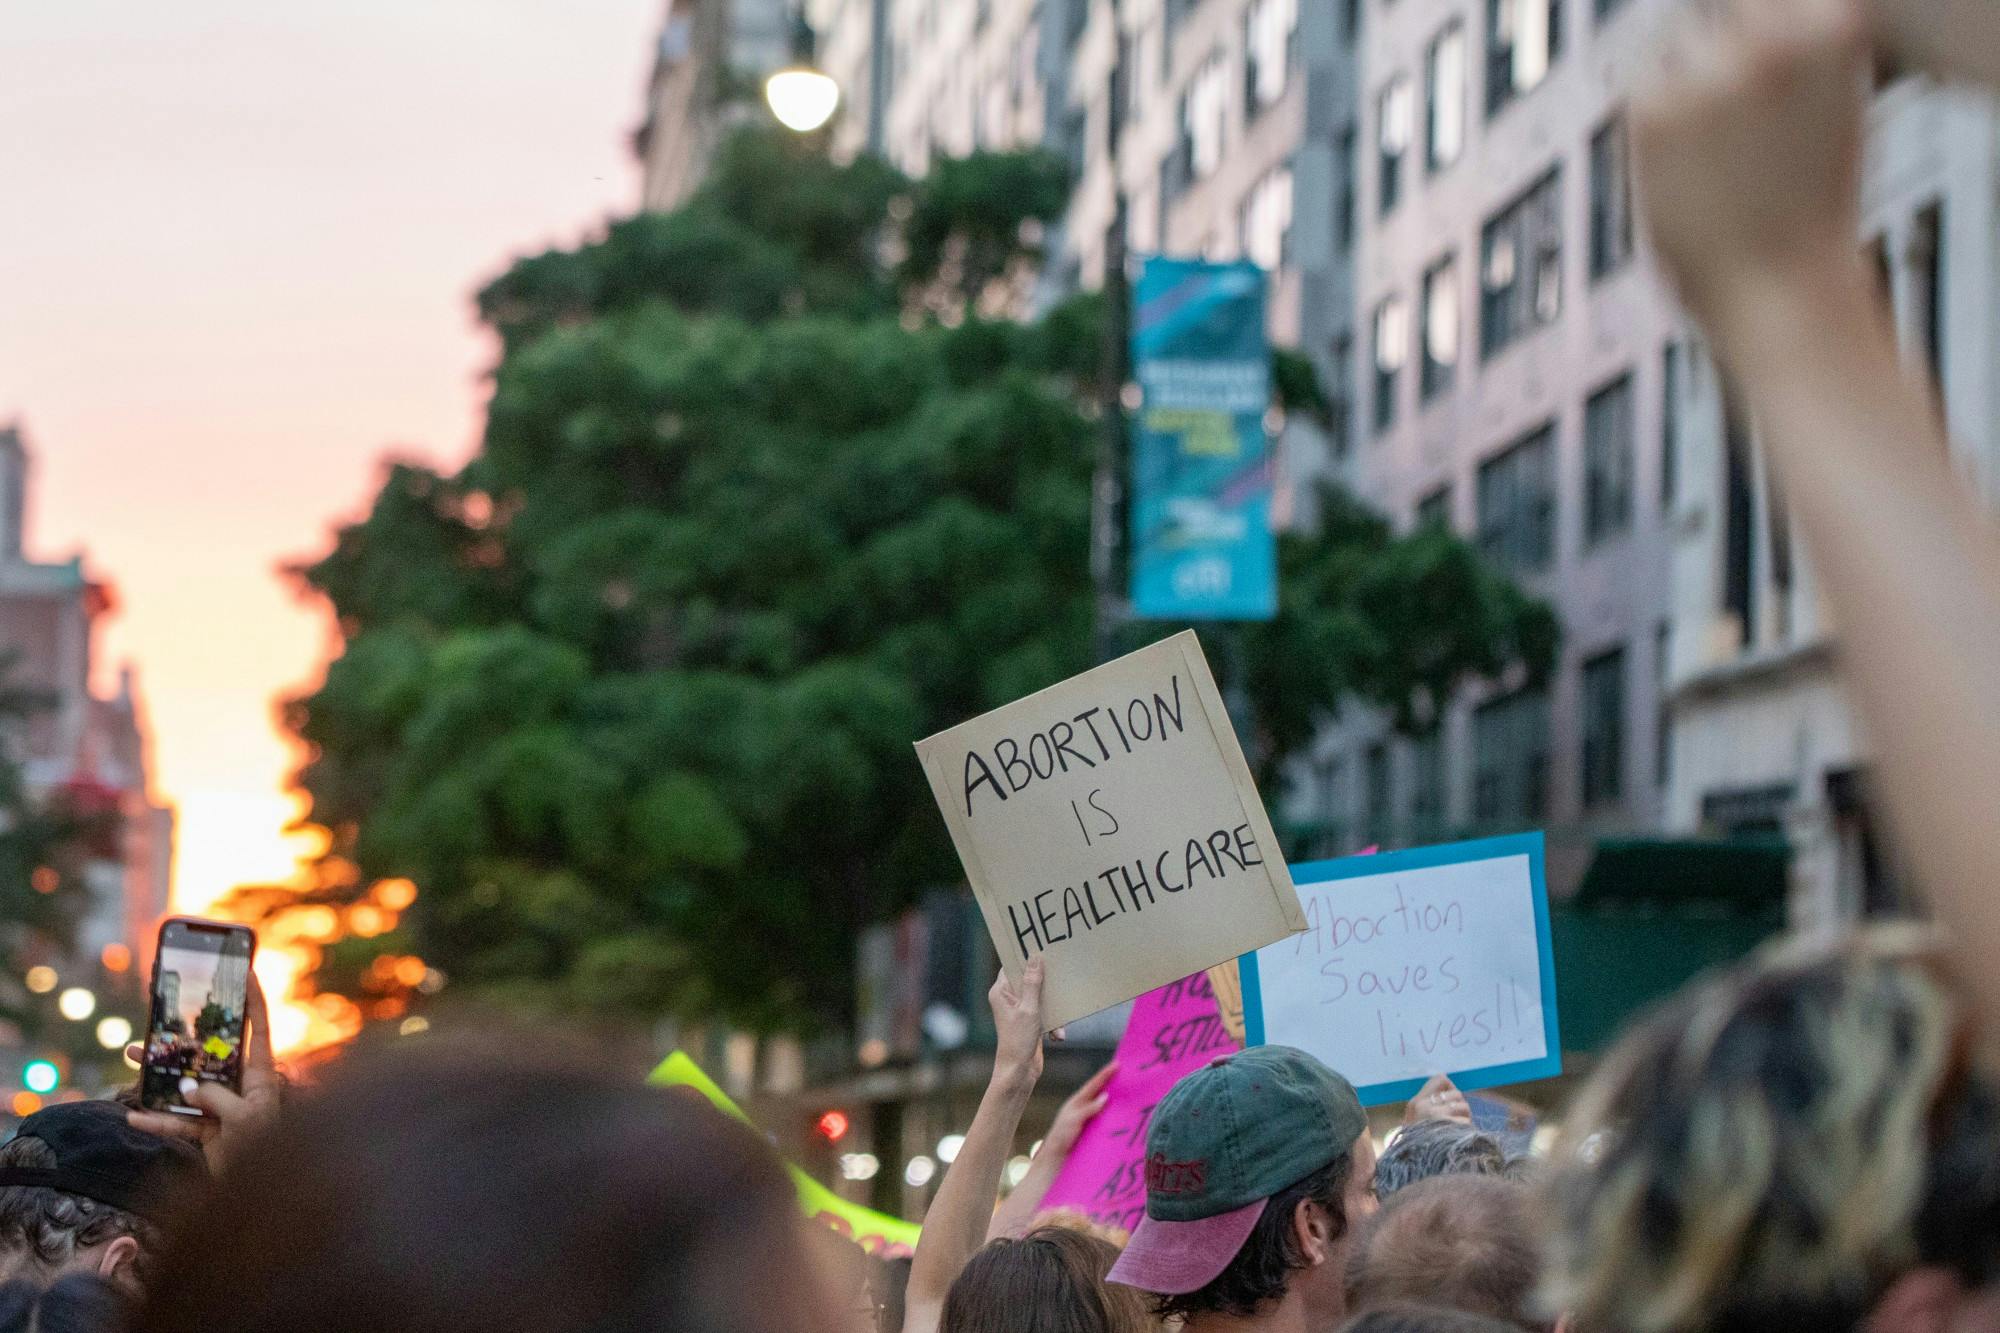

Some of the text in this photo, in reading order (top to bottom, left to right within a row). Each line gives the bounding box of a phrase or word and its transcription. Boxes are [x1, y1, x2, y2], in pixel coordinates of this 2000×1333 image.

[963, 675, 1184, 817] ABORTION
[1071, 788, 1119, 847] IS
[1007, 823, 1264, 961] HEALTHCARE
[1296, 884, 1463, 955] Abortion
[1320, 956, 1460, 1004] Saves
[1376, 977, 1524, 1056] lives!!
